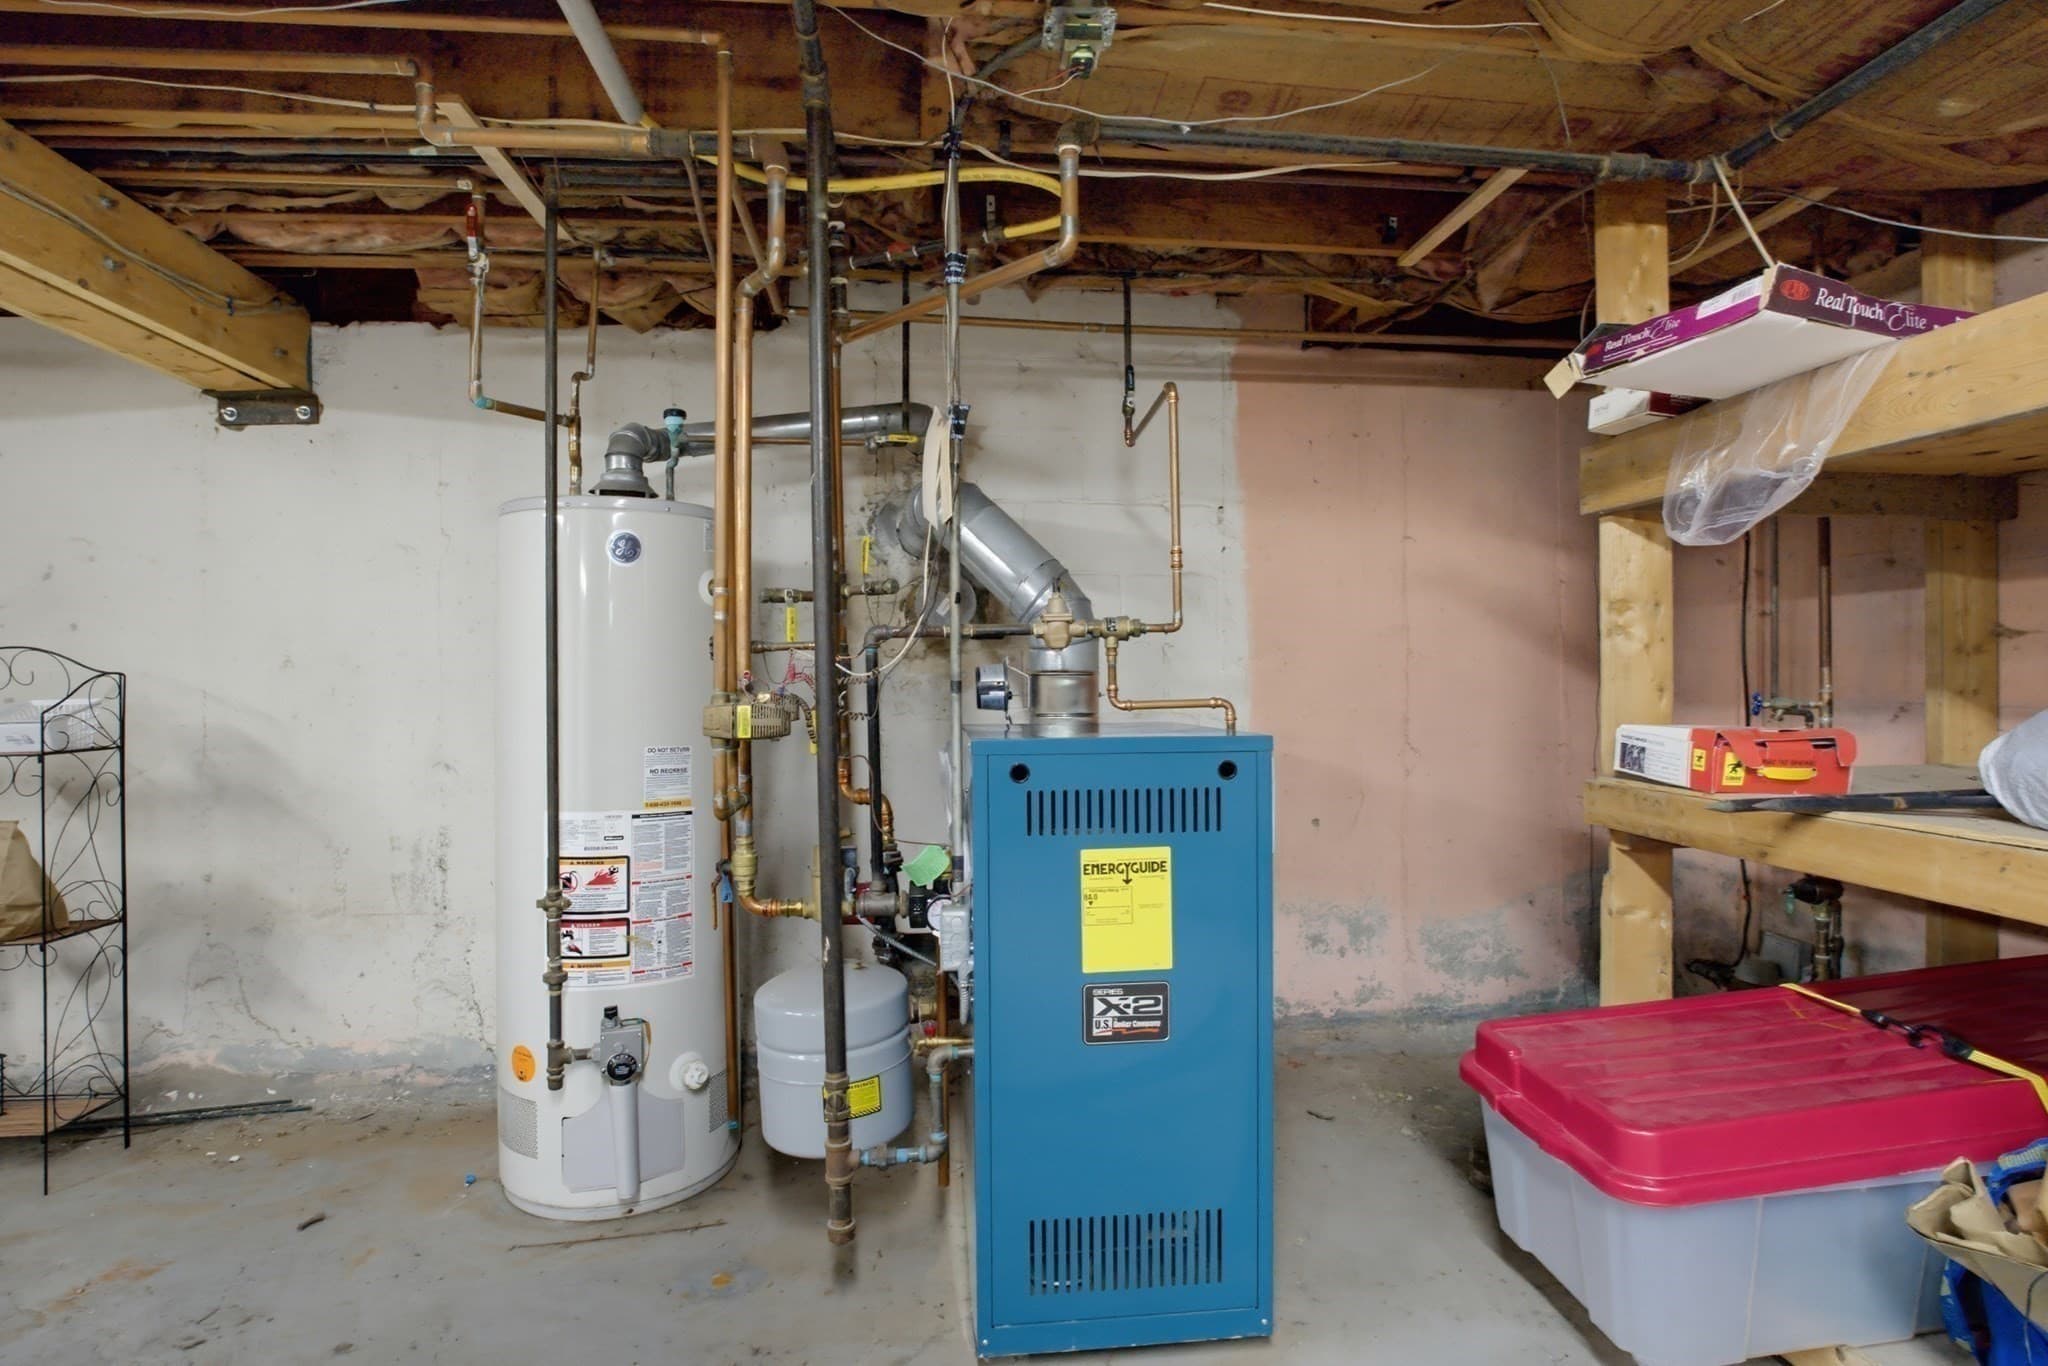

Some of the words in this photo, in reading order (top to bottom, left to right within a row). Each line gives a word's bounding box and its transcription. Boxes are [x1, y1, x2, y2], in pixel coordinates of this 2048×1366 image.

[1815, 287, 1846, 311] Real
[1846, 295, 1884, 327] Touch
[1883, 301, 1928, 331] Elite
[1083, 860, 1168, 880] ENERGYGUIDE
